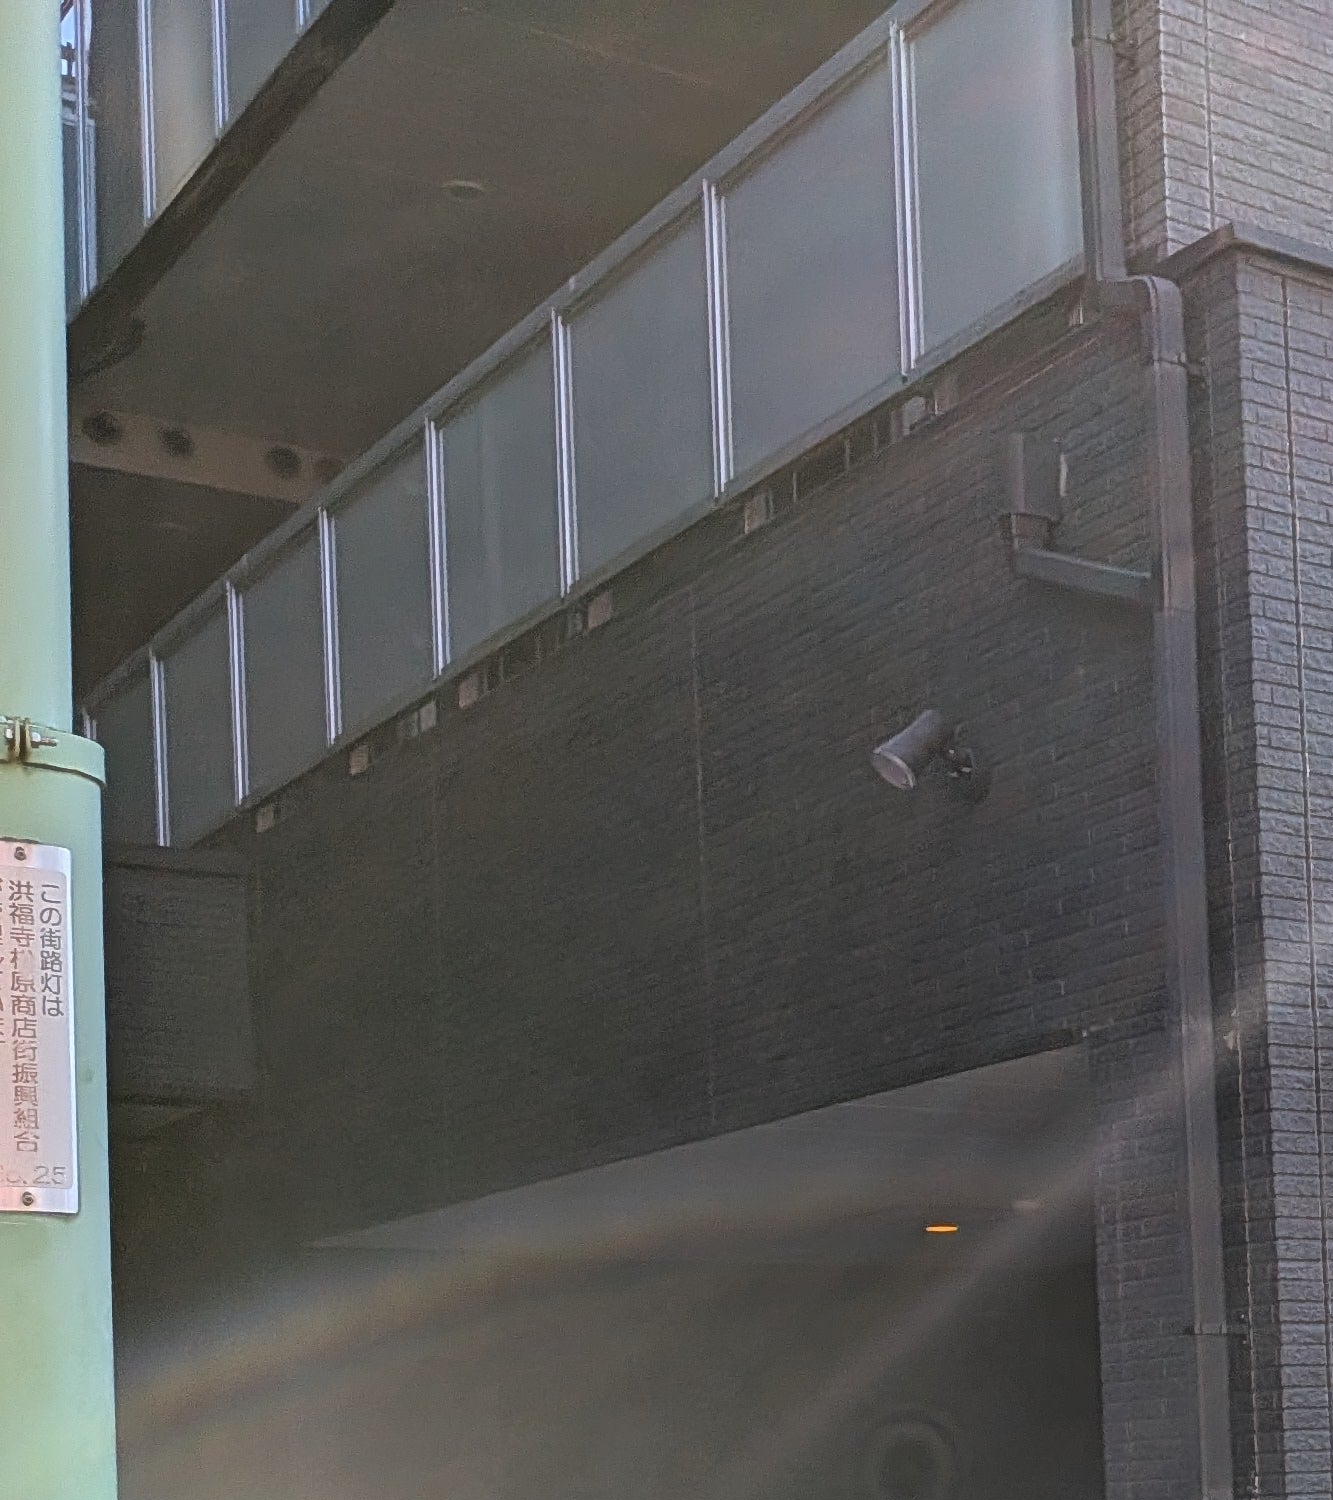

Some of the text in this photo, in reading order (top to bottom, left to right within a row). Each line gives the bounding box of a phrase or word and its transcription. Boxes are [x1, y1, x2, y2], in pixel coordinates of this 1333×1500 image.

[40, 884, 65, 1017] この街路灯は
